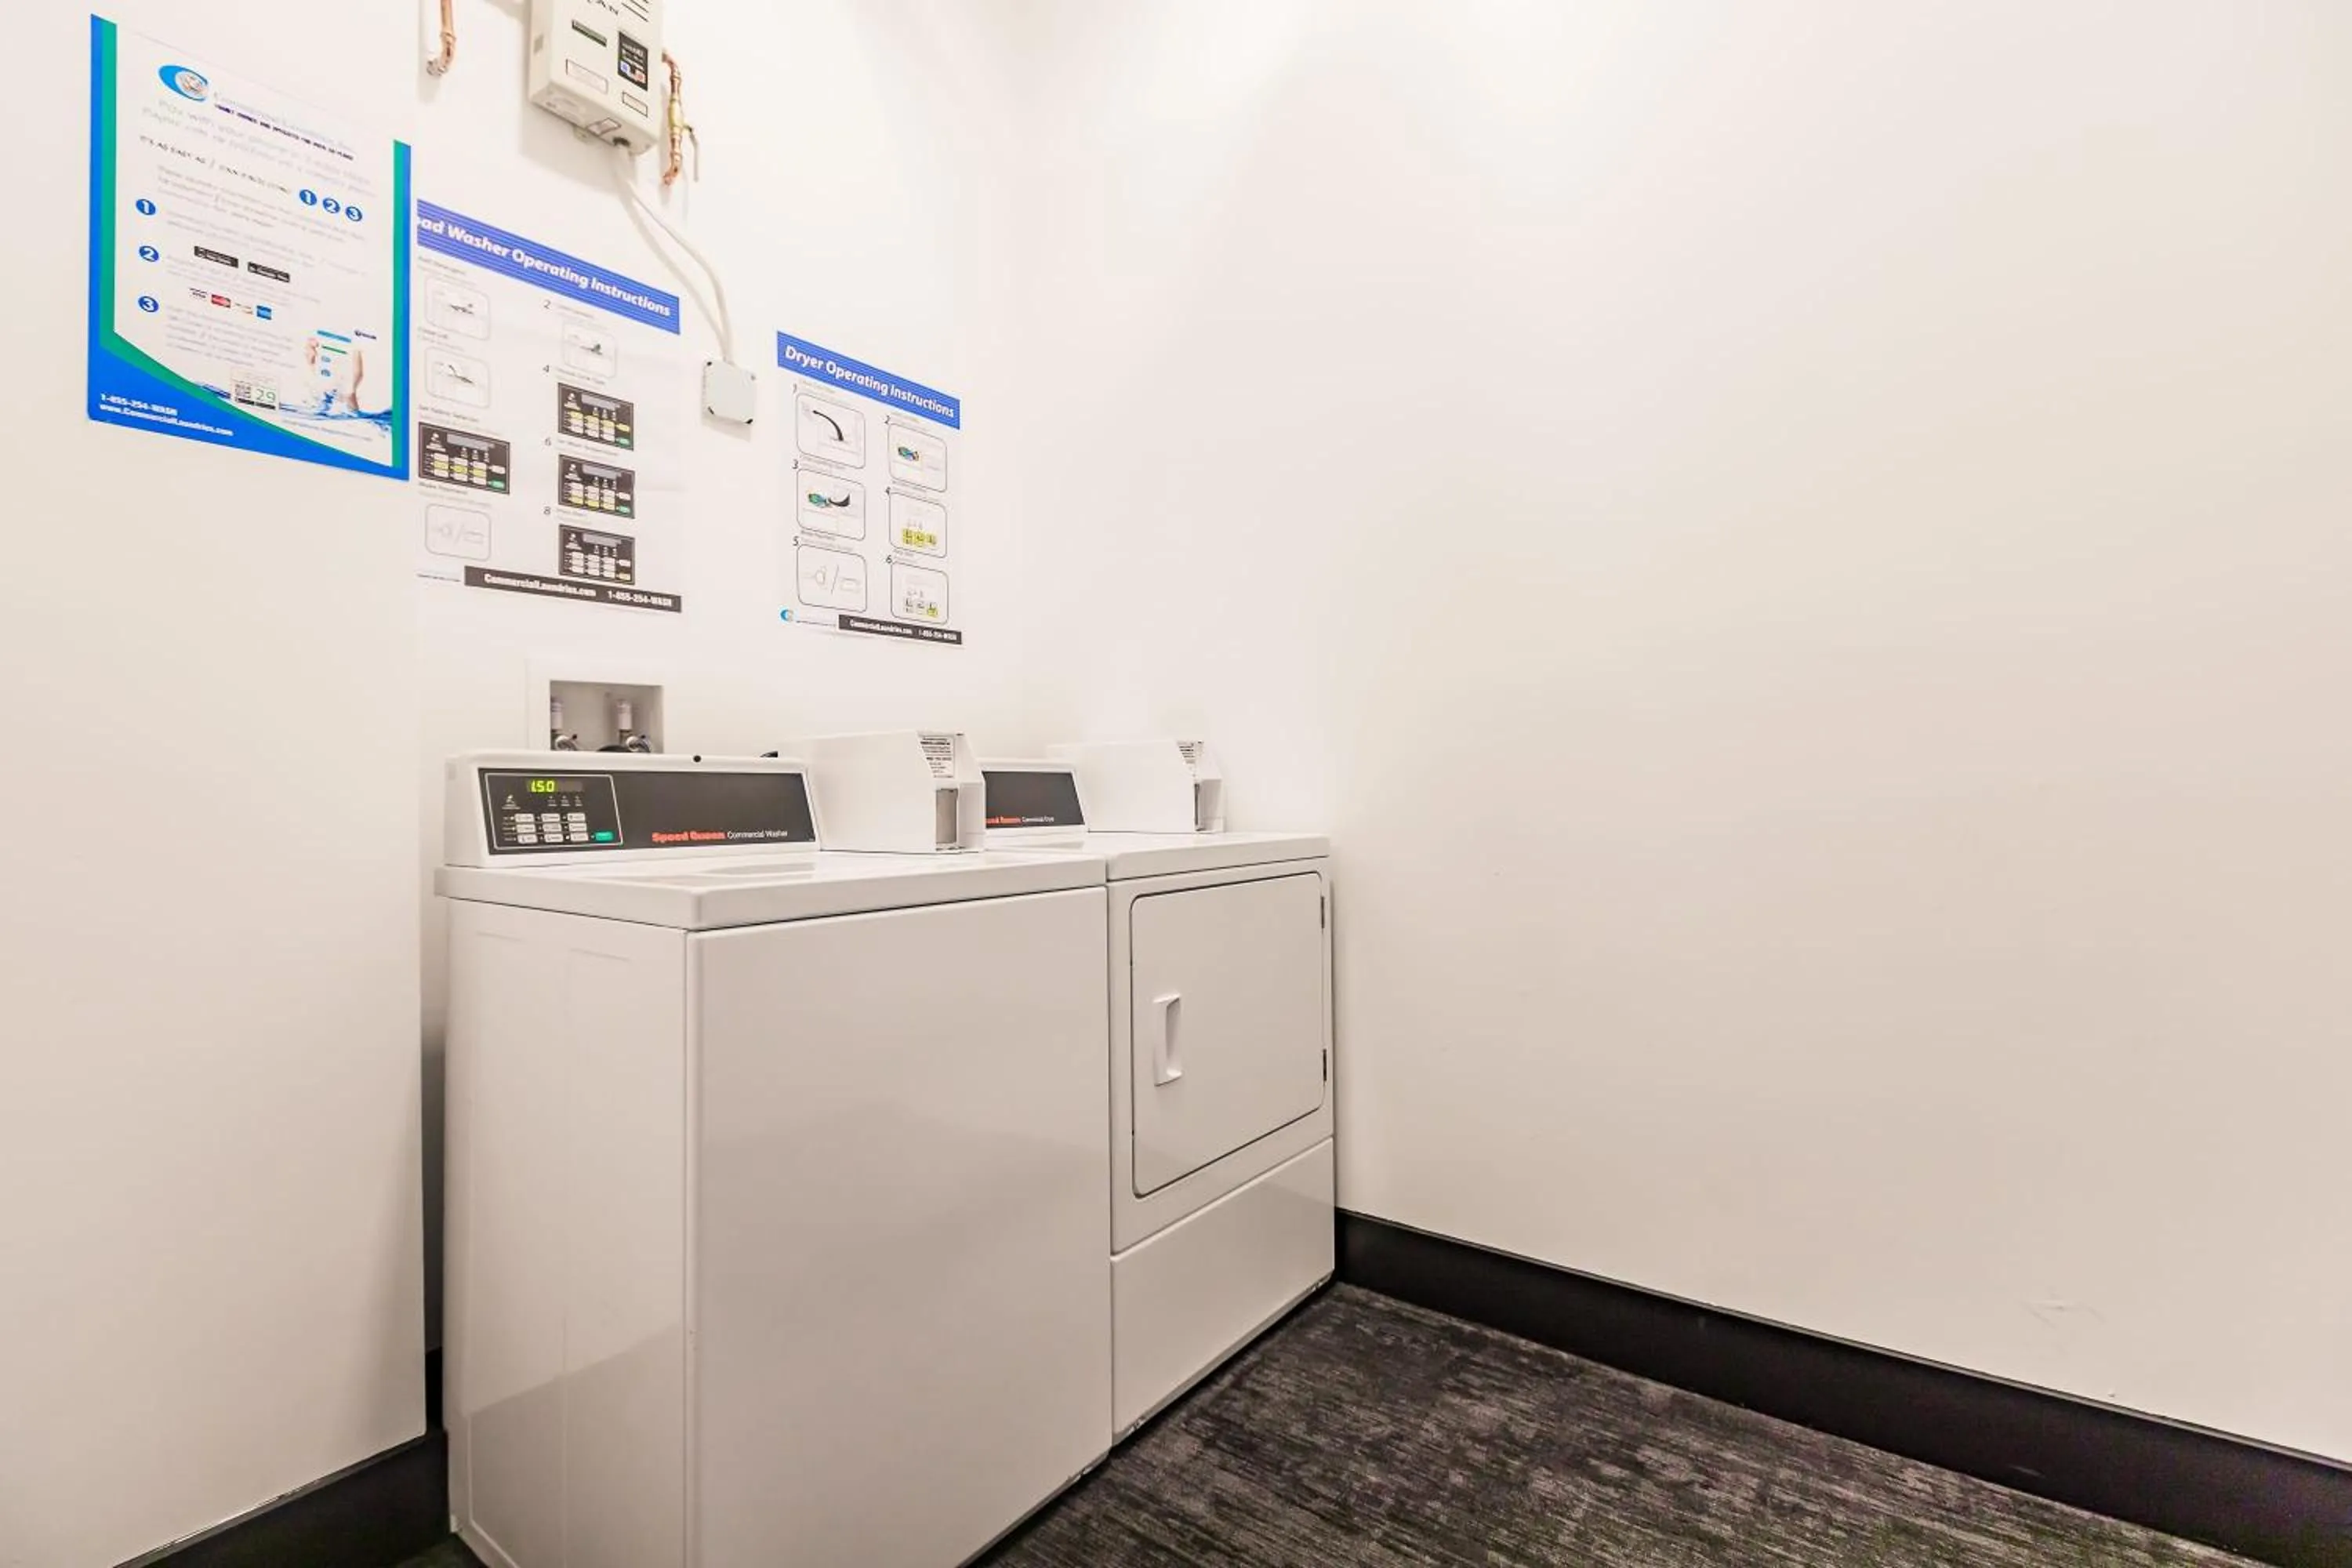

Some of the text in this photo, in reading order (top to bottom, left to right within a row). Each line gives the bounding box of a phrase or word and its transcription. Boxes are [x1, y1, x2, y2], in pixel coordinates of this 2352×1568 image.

[448, 224, 510, 257] Washer
[511, 249, 590, 289] Operating
[591, 277, 671, 316] Instructions
[543, 299, 551, 310] 2
[543, 365, 550, 373] 4
[785, 345, 824, 370] Dryer
[826, 361, 889, 396] Operating
[891, 384, 955, 418] Instructions
[793, 459, 799, 469] 3
[793, 536, 799, 546] 5
[886, 555, 892, 564] 6
[652, 832, 689, 843] Speed
[689, 830, 726, 840] Queen
[727, 829, 764, 840] Commercial
